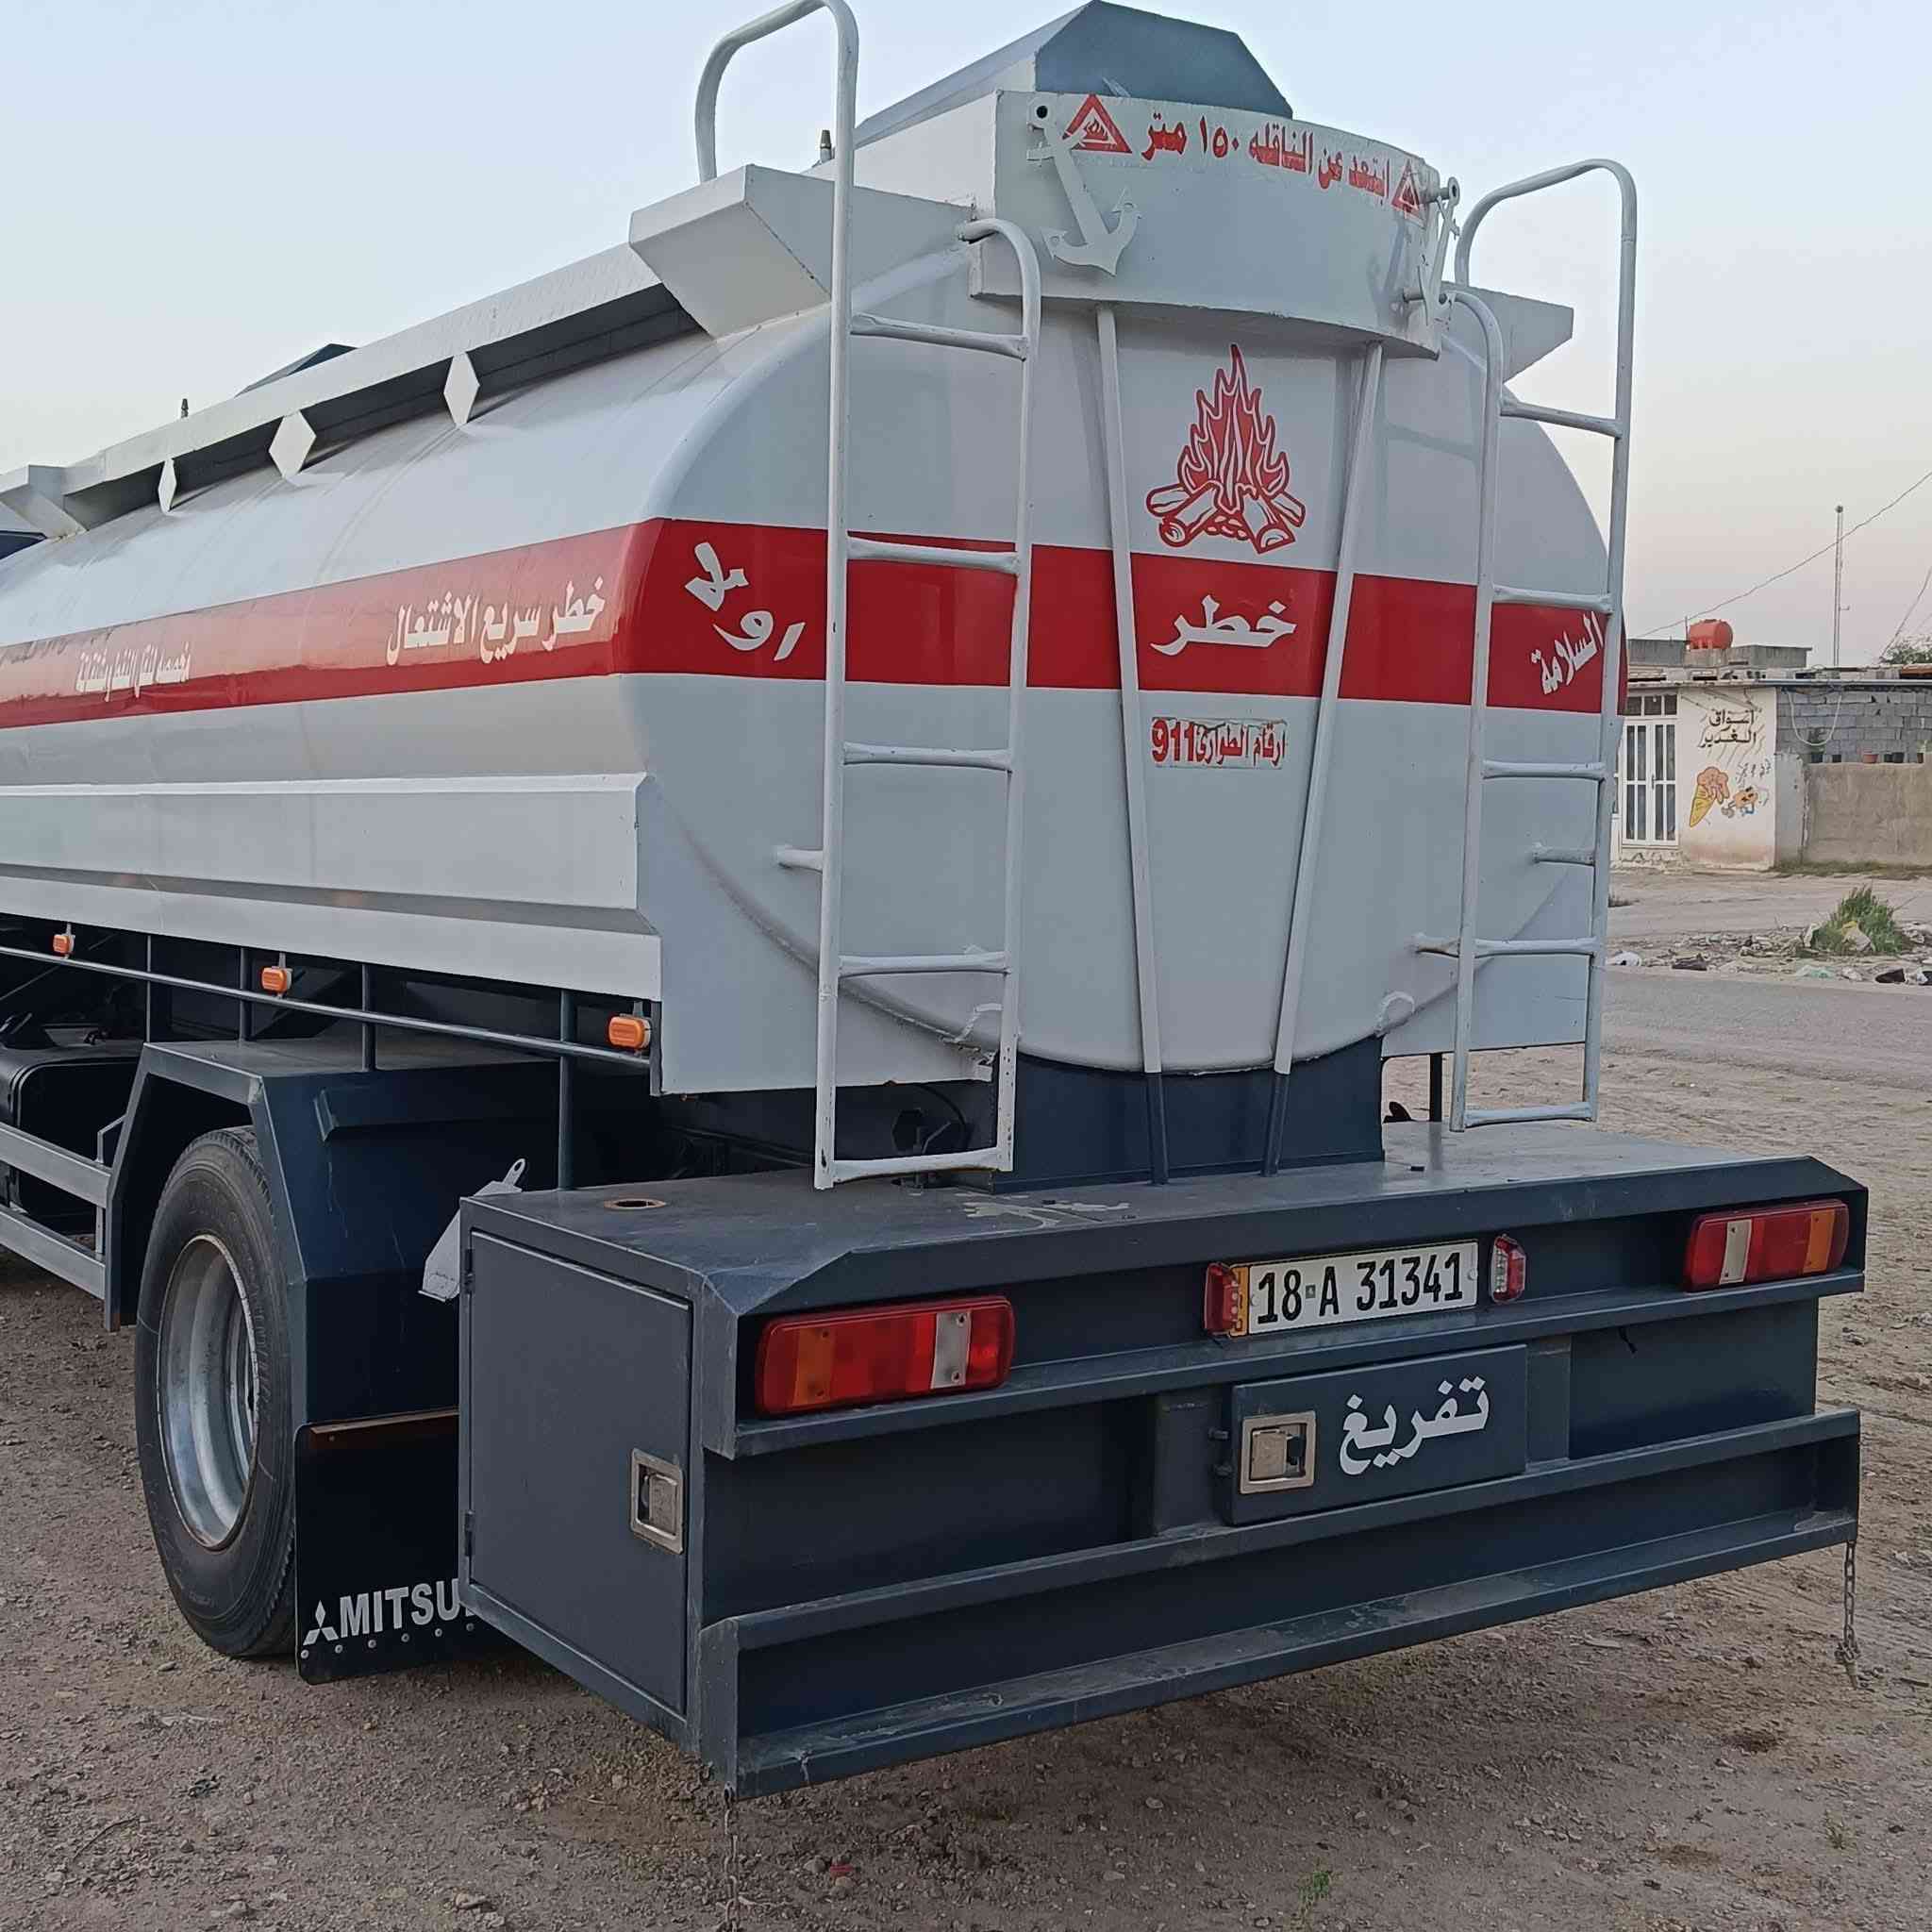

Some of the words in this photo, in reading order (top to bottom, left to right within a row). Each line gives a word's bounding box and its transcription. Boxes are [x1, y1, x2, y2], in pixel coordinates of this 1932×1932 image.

[1141, 112, 1188, 161] متر
[1318, 146, 1343, 190] عن
[386, 591, 480, 666] الاشتعال
[480, 602, 541, 664] سريع
[541, 576, 607, 651] خطر
[1150, 594, 1298, 657] خطر
[1530, 610, 1604, 695] السلامة
[1152, 719, 1194, 762] 911
[1257, 1269, 1303, 1324] 18
[1319, 1266, 1341, 1318] A
[1356, 1251, 1463, 1311] 31341
[1339, 1374, 1491, 1476] تفريغ
[340, 1577, 475, 1639] MITSU
